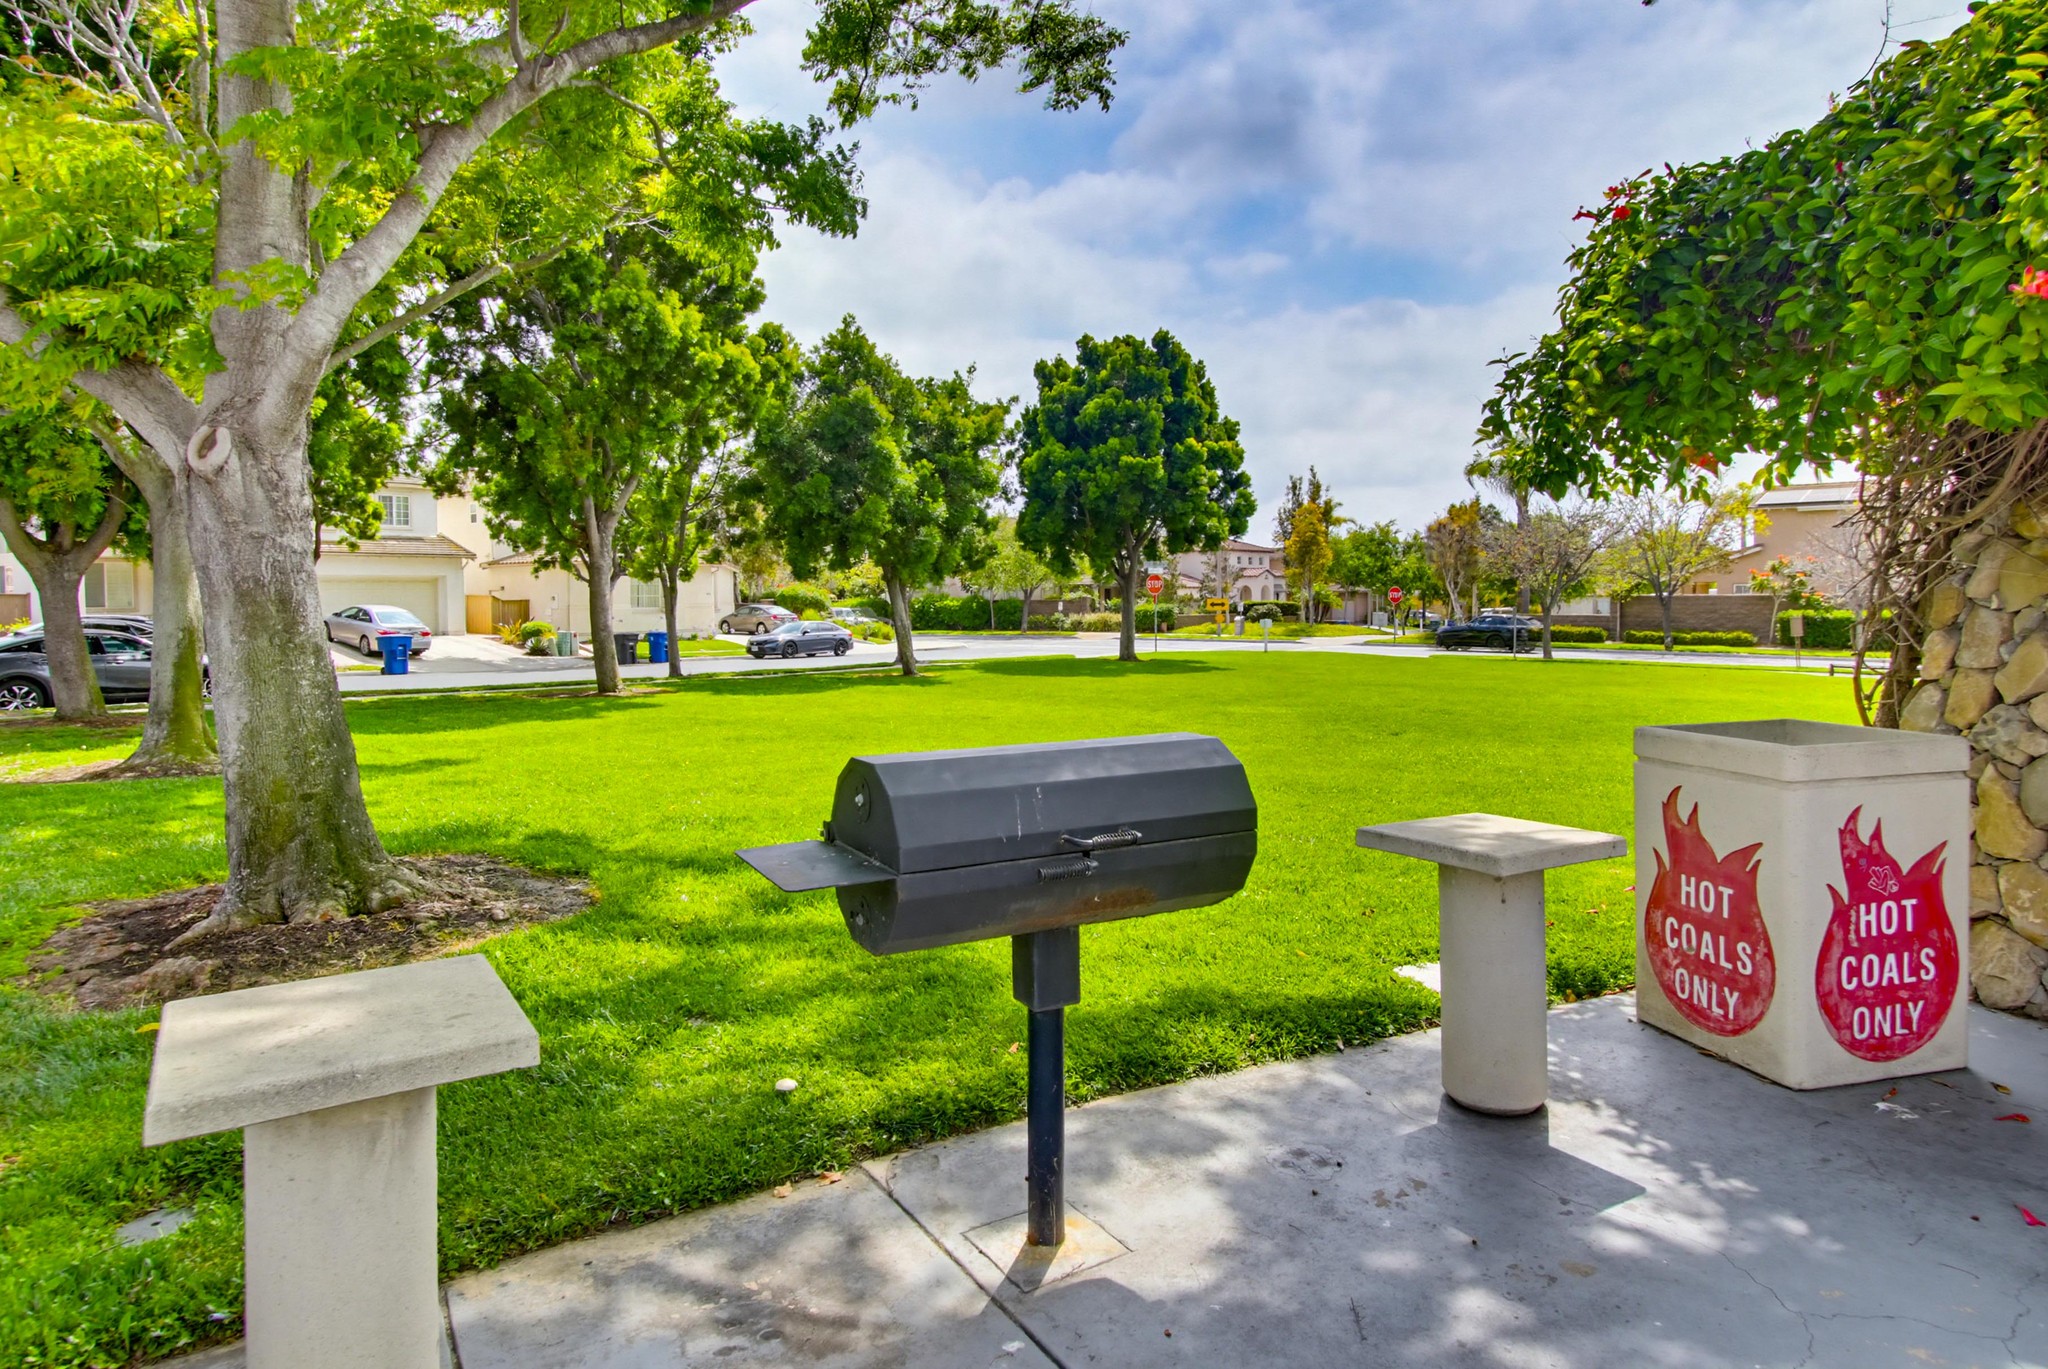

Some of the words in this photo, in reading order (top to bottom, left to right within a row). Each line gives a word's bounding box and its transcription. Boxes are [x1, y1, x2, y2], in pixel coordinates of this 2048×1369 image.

[1147, 580, 1163, 588] STOP
[1680, 873, 1734, 919] HOT
[1859, 898, 1918, 938] HOT
[1665, 916, 1752, 975] COALS
[1840, 947, 1936, 991] COALS
[1674, 967, 1740, 1020] ONLY
[1852, 1000, 1925, 1041] ONLY
